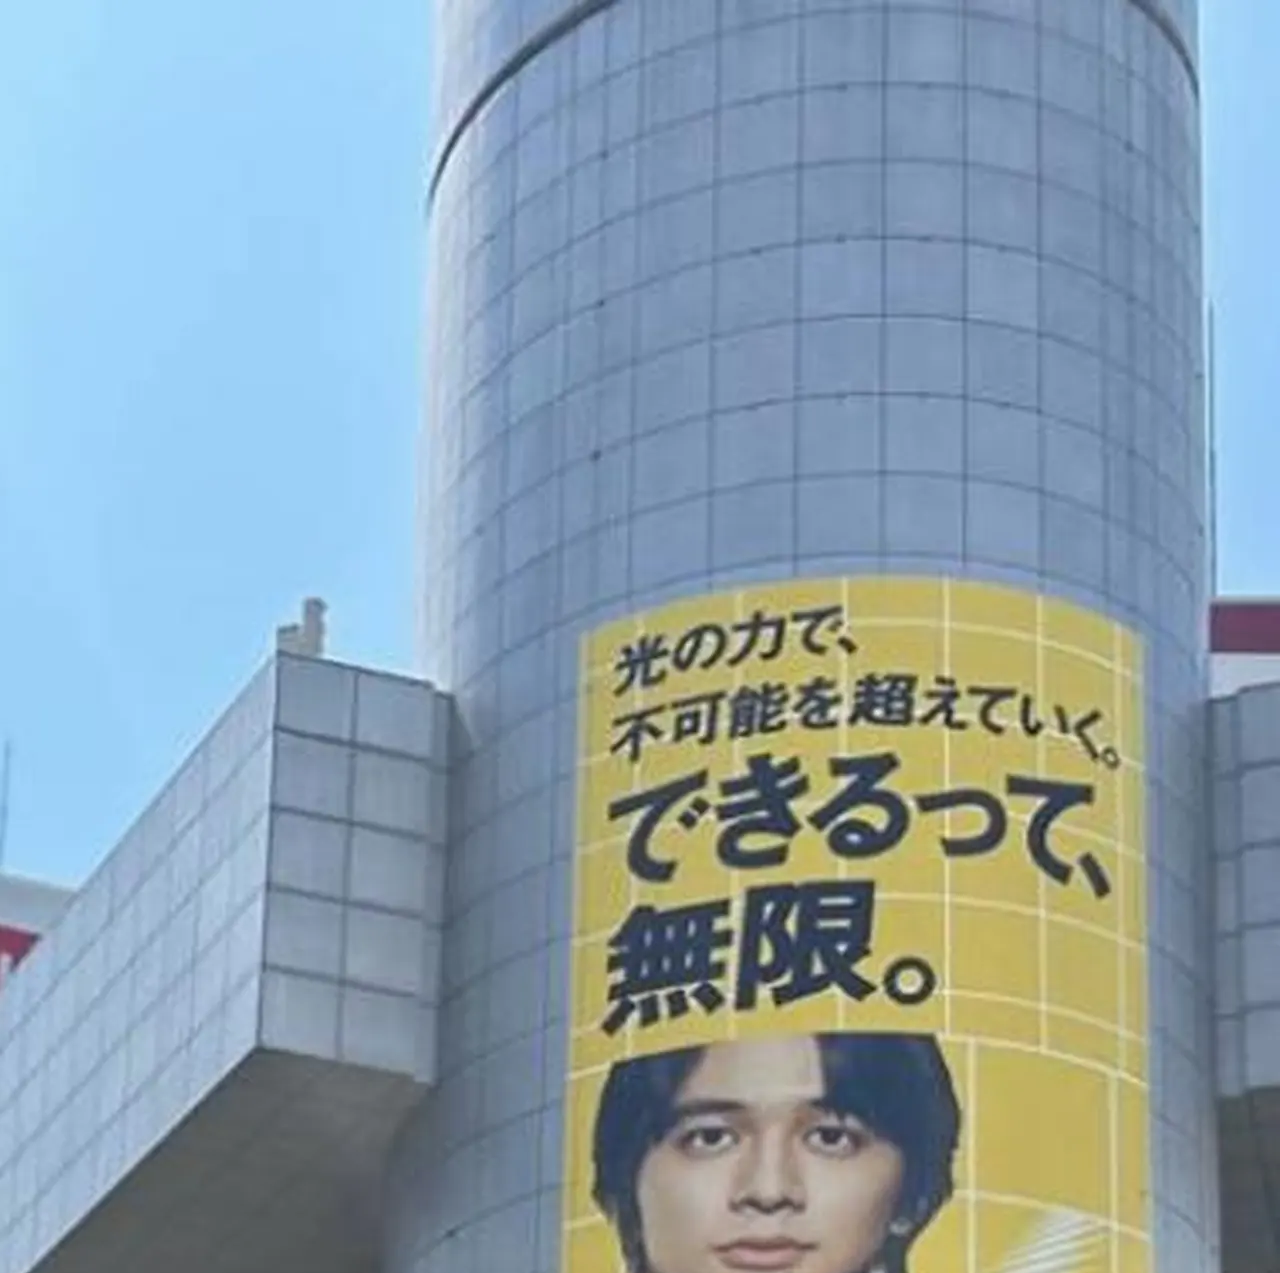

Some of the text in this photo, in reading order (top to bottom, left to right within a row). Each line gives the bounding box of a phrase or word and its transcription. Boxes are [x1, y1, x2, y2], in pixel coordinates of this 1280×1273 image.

[612, 604, 859, 698] 光の力で、
[609, 672, 1124, 772] 不可能を超えていく。
[608, 750, 1111, 900] できるって、
[601, 879, 938, 1038] 無限。
